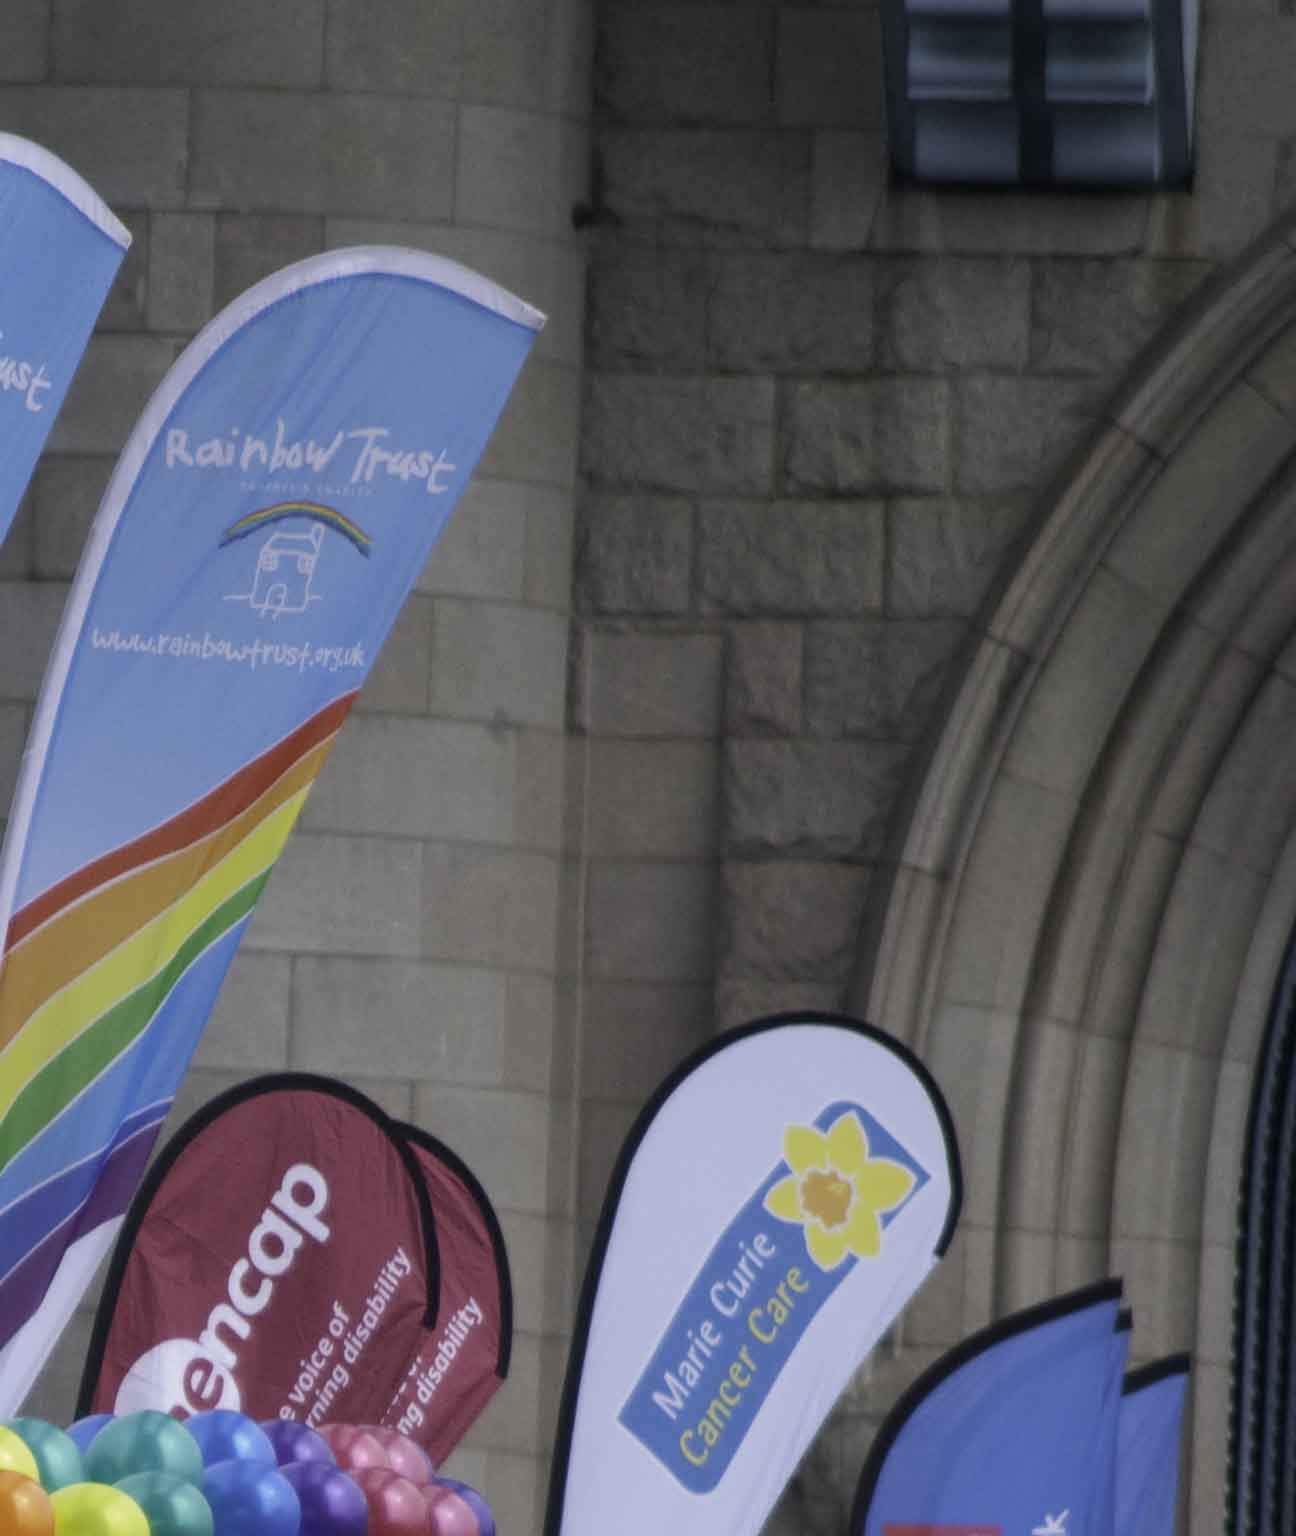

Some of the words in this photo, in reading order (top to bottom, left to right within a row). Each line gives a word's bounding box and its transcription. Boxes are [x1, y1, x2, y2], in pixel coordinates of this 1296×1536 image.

[164, 416, 345, 474] Rainbow
[348, 426, 457, 494] Trust
[91, 629, 366, 672] www.rainbowtrust.org.uk
[168, 1163, 331, 1420] encap
[288, 1336, 335, 1403] voice
[329, 1300, 350, 1337] of
[305, 1363, 350, 1429] rning
[342, 1247, 411, 1364] disability
[415, 1296, 483, 1405] disability
[652, 1320, 722, 1421] Marie
[709, 1232, 777, 1318] Curie
[679, 1344, 758, 1466] Cancer
[747, 1267, 810, 1345] Care
